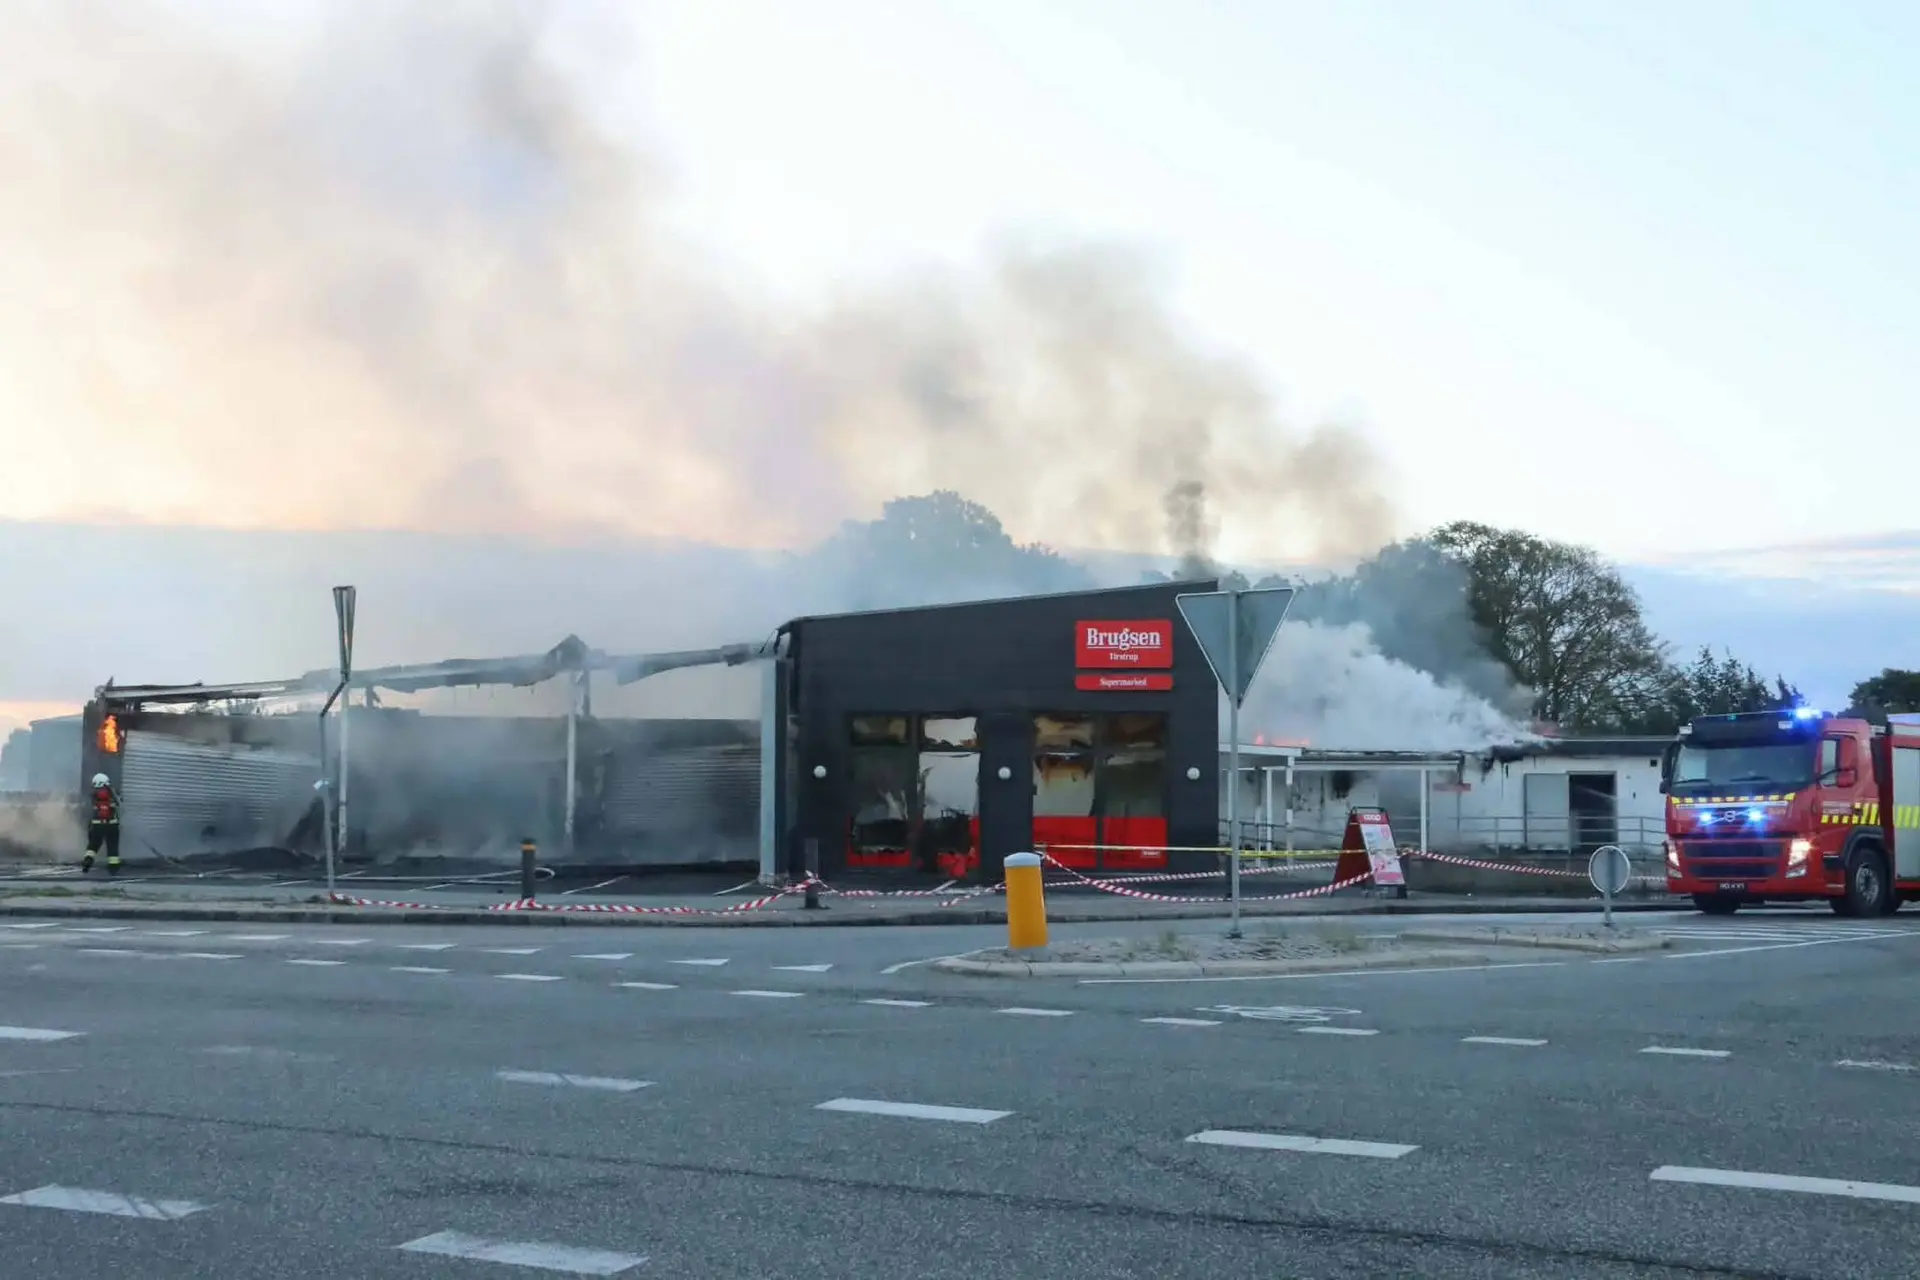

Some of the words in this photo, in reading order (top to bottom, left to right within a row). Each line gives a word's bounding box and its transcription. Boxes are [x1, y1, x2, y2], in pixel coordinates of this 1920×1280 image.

[1086, 628, 1161, 651] Brugsen
[1109, 652, 1139, 662] Tirstrup
[1100, 677, 1147, 687] Supermarked
